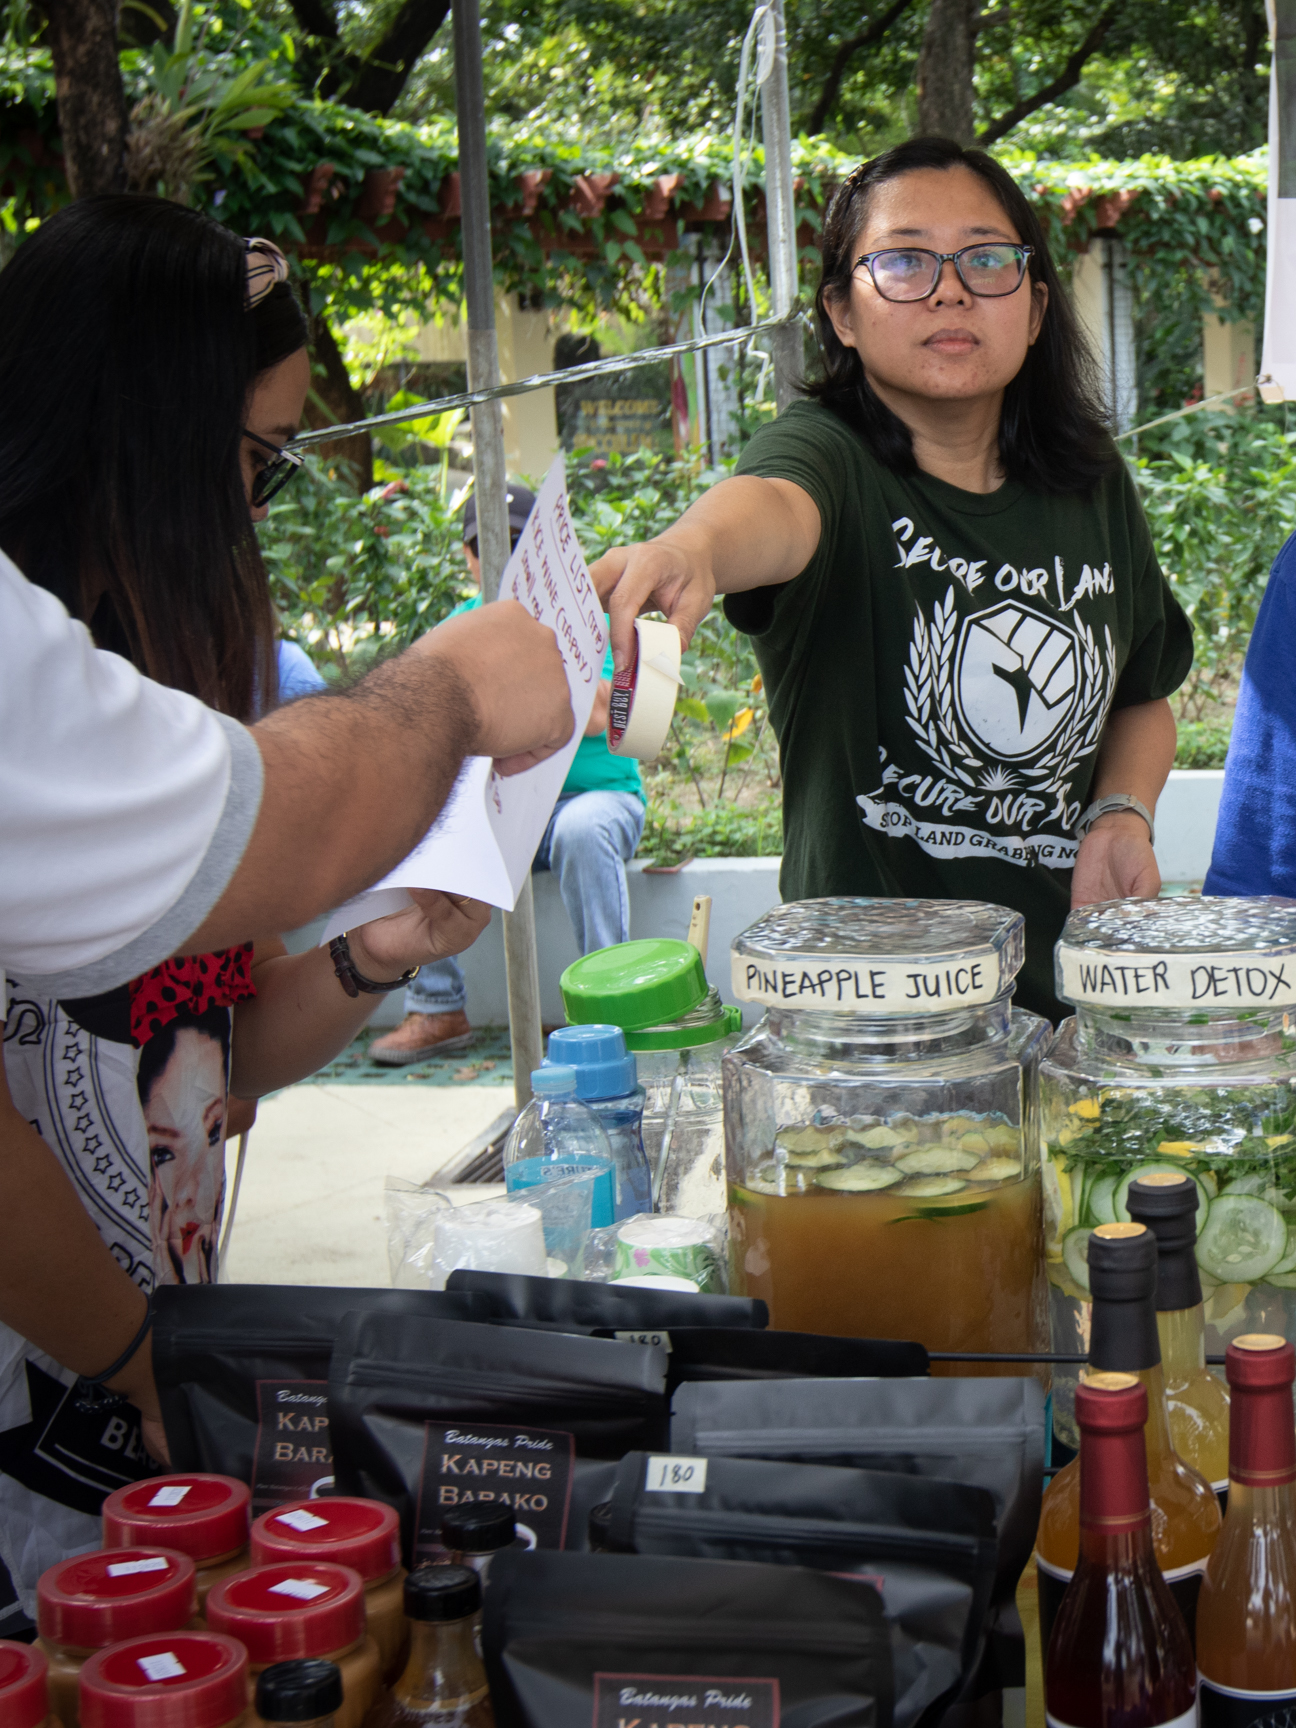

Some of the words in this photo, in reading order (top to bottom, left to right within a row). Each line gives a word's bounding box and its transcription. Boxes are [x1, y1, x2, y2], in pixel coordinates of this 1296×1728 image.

[914, 826, 965, 846] LAND
[746, 964, 887, 1000] PINEAPPLE
[906, 962, 984, 998] JUICE
[1079, 961, 1171, 996] WATER
[1190, 962, 1293, 999] DETOX
[444, 1430, 510, 1449] Batangas
[514, 1434, 554, 1451] Pride
[659, 1465, 695, 1487] 180
[619, 1687, 697, 1712] Batangas
[704, 1689, 753, 1710] Pride
